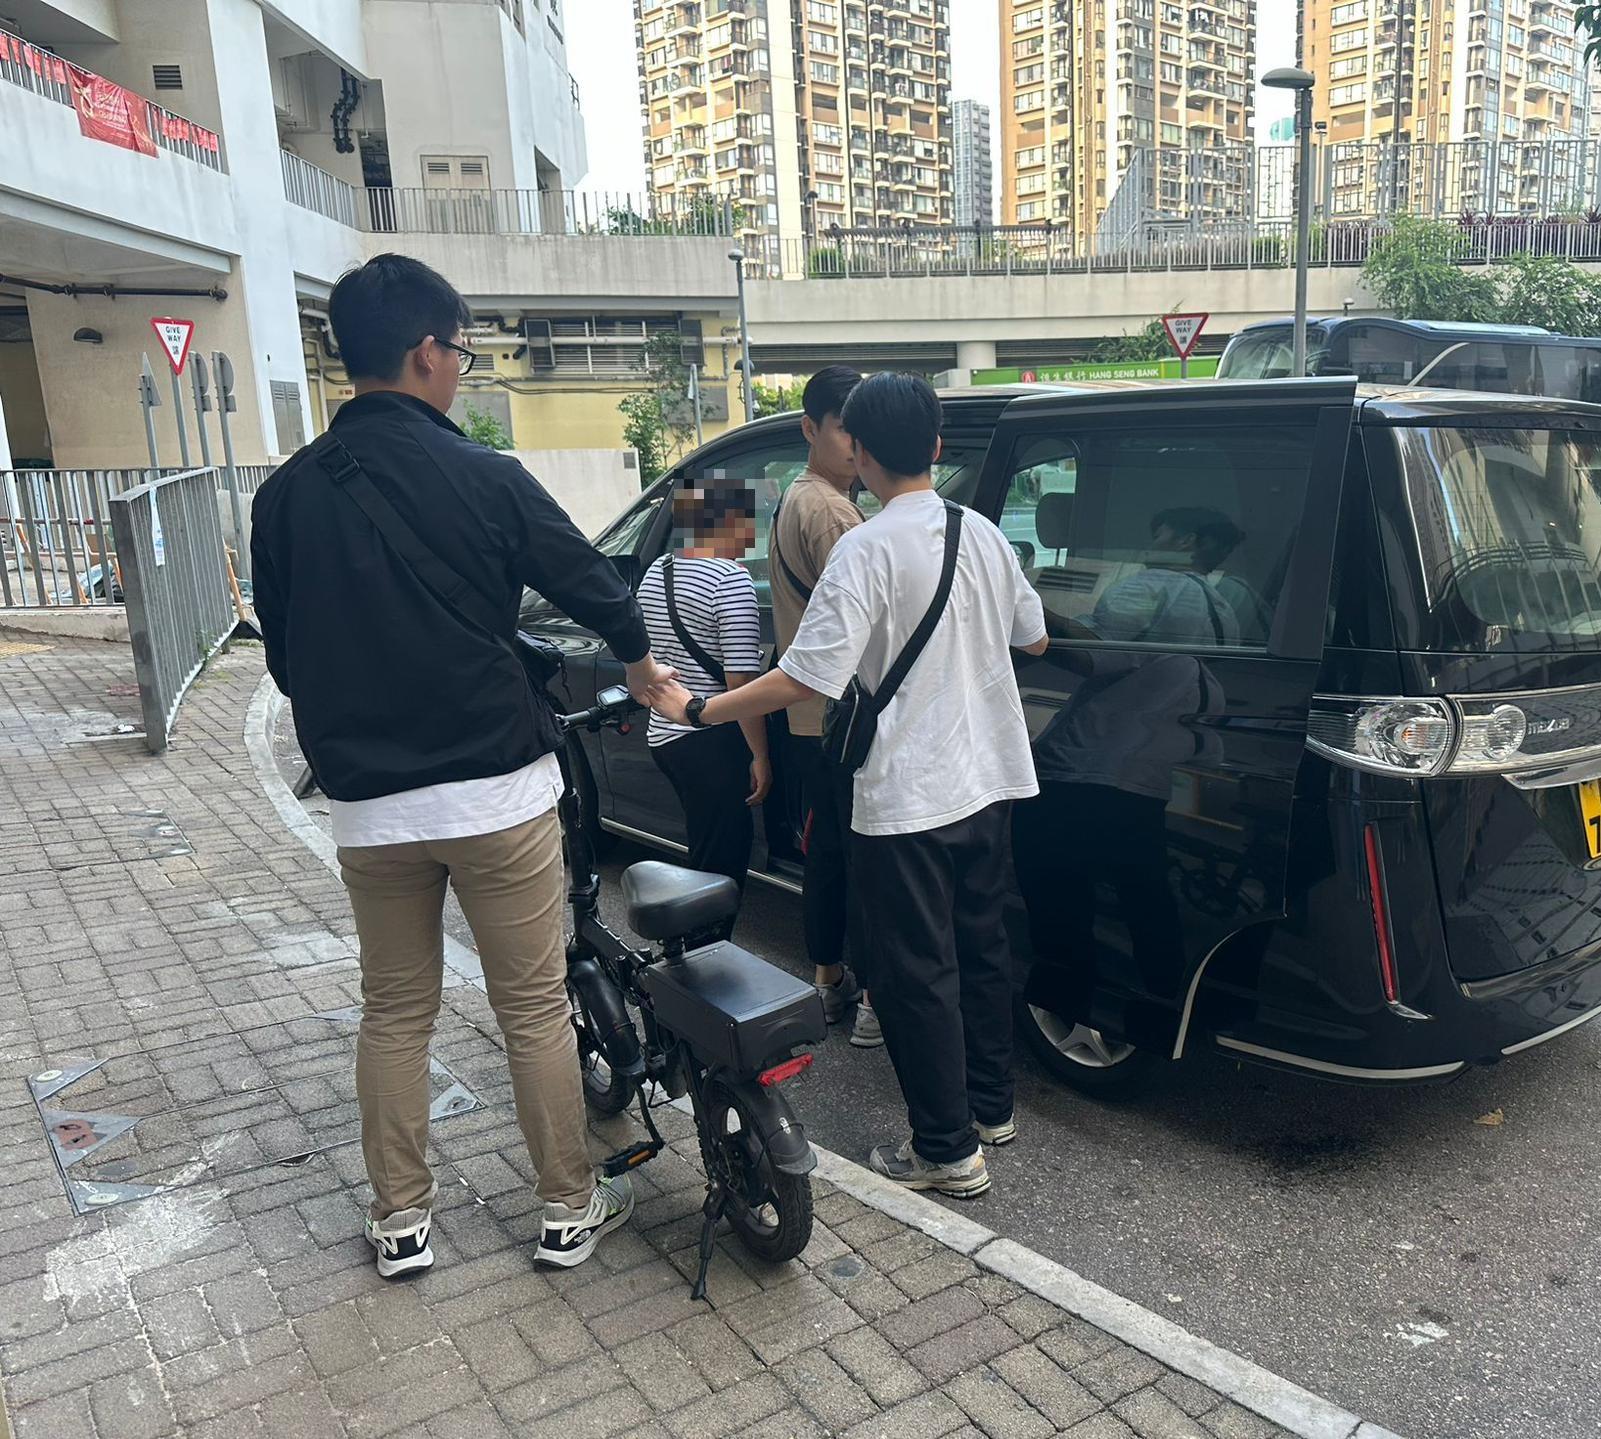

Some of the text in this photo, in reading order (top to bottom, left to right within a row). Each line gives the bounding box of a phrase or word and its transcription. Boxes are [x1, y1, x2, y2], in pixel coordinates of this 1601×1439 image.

[165, 326, 180, 334] GIVE
[1089, 368, 1159, 379] HANG SENG BANK
